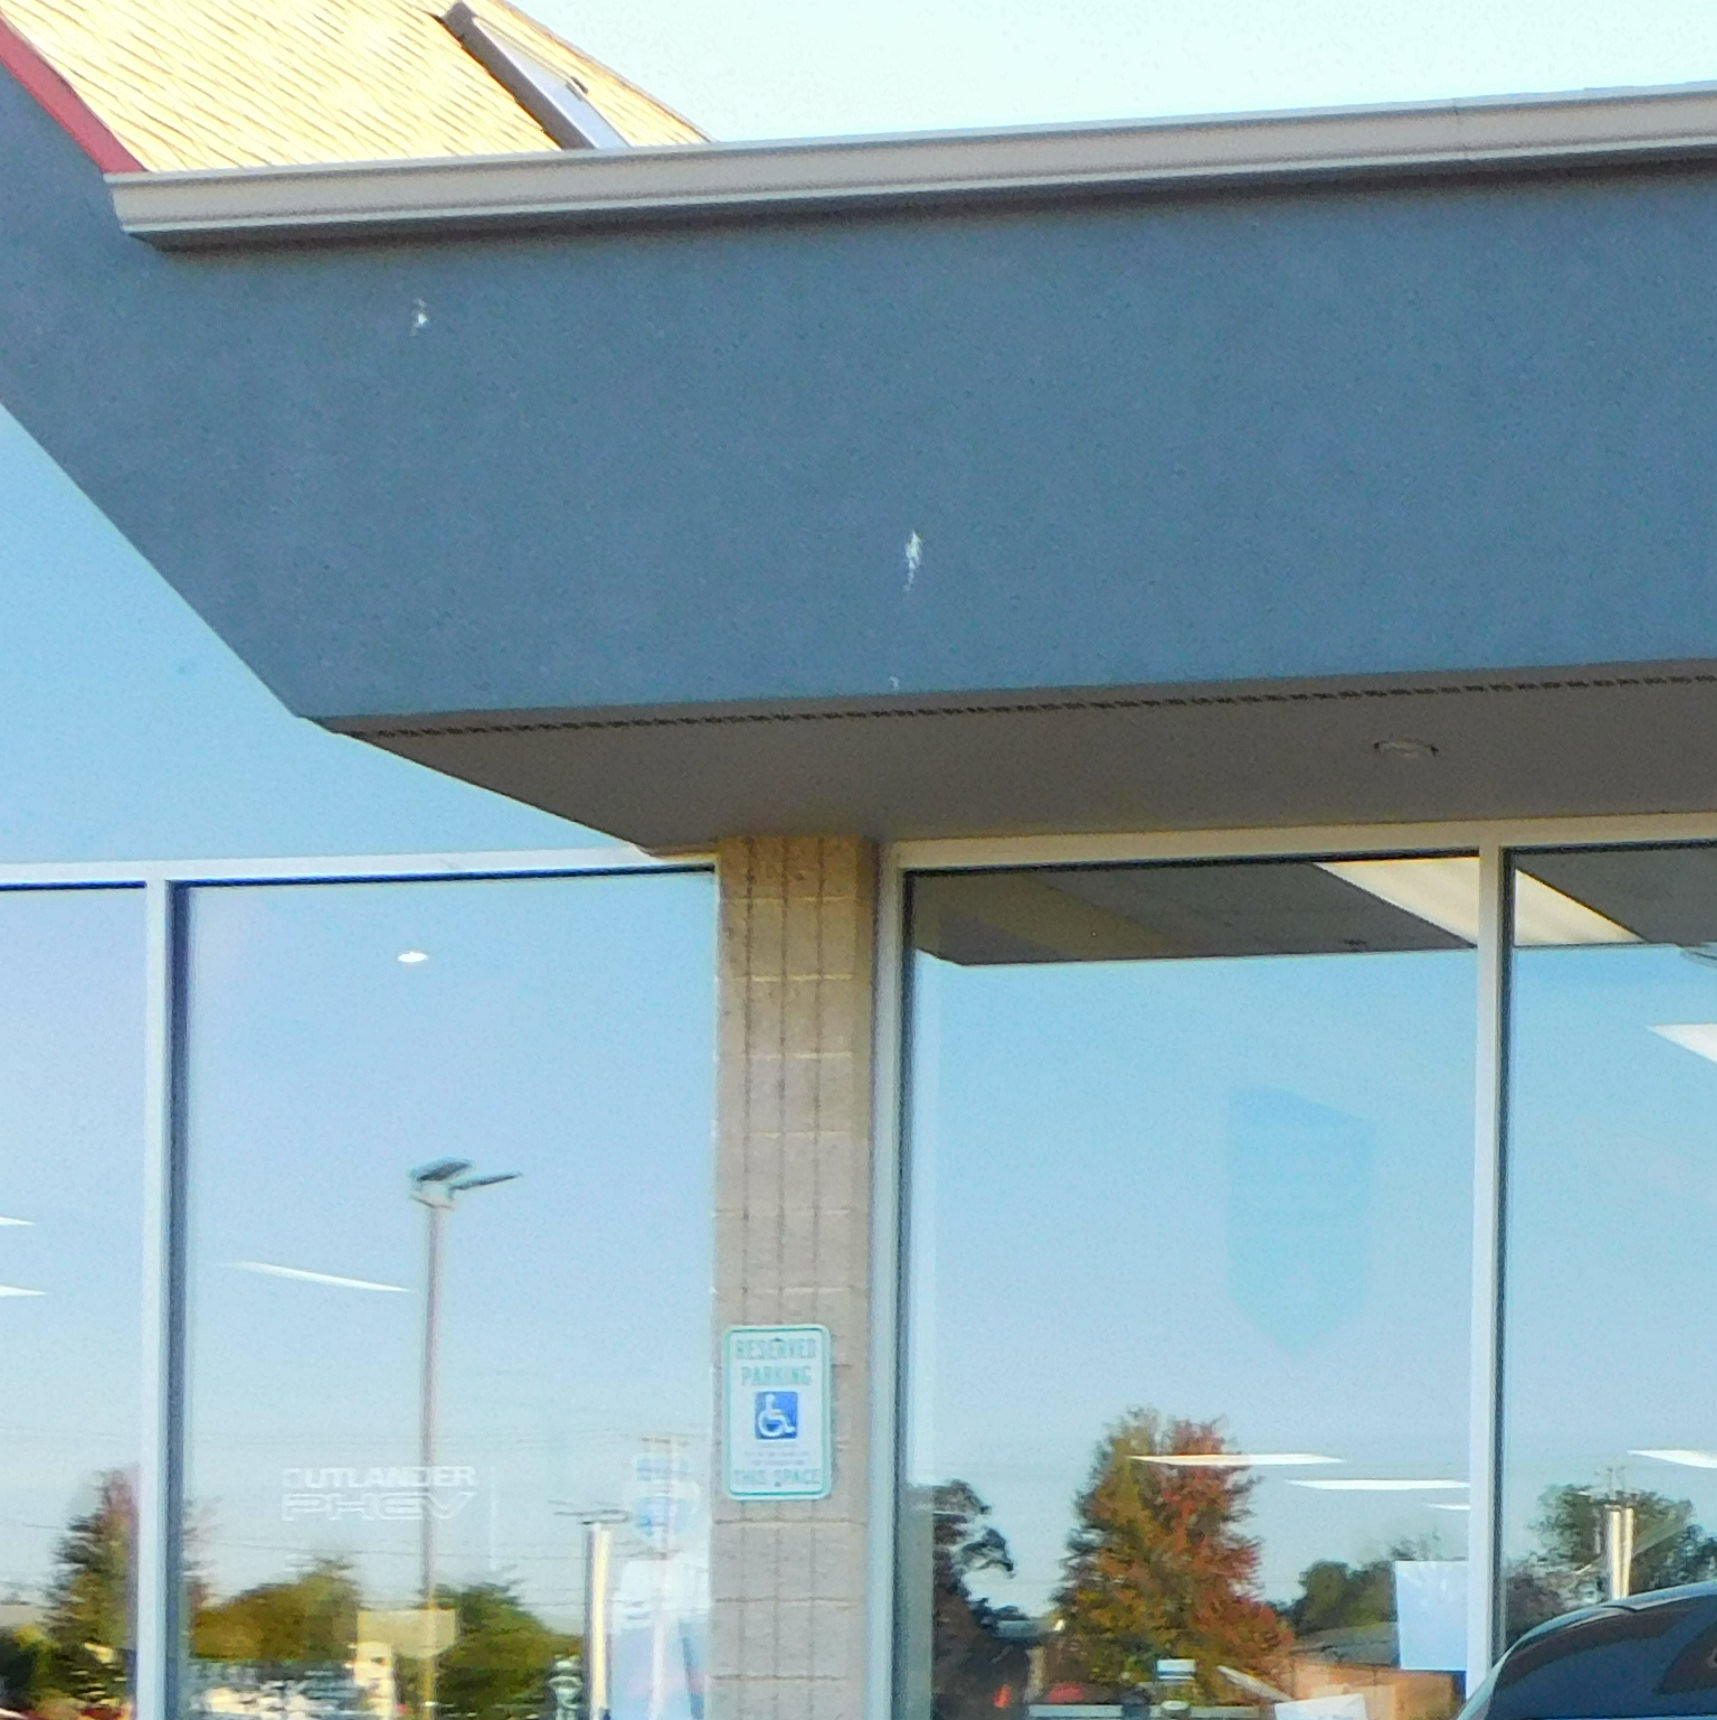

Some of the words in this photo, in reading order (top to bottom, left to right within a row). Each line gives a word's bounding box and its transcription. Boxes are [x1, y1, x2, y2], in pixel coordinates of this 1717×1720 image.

[735, 1338, 817, 1360] RESERVED
[741, 1366, 812, 1386] PARKING
[282, 1466, 478, 1489] OUTLANDER
[281, 1492, 477, 1522] PHEV
